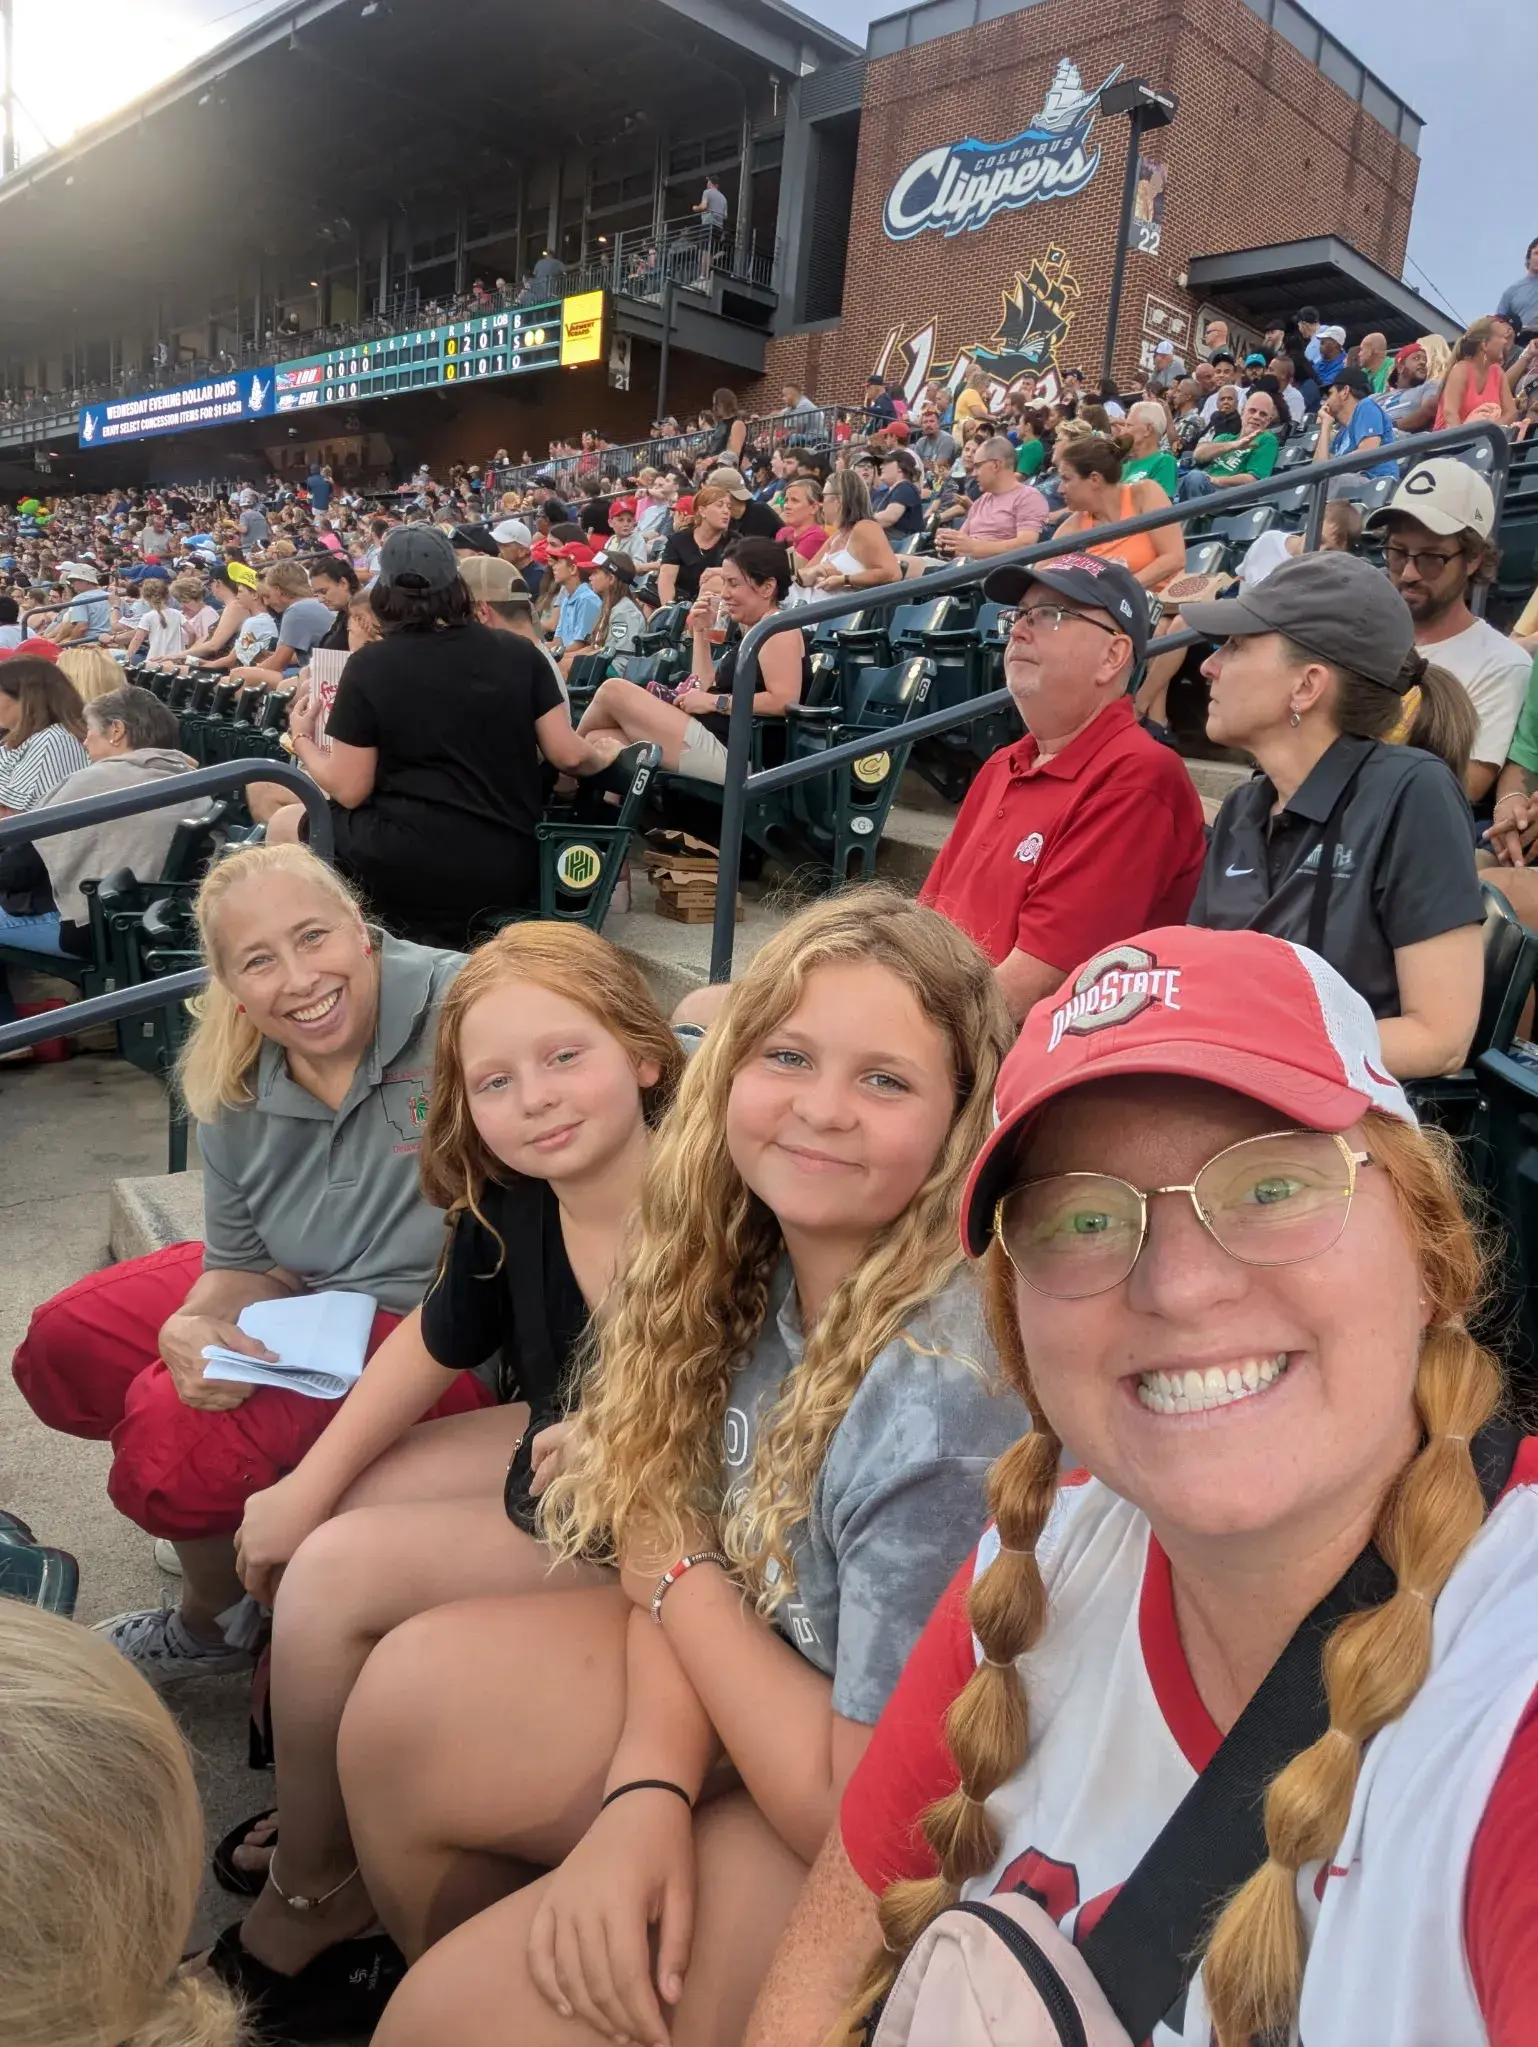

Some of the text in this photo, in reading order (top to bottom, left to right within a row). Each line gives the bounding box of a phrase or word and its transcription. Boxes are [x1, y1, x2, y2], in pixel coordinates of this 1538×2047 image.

[975, 137, 1074, 172] COLUMBUS
[887, 145, 1098, 229] Clippers
[1137, 227, 1161, 256] 22
[339, 351, 344, 360] 2
[351, 348, 356, 358] 3
[363, 345, 368, 356] 4
[376, 342, 381, 353] 5
[389, 339, 395, 350] 6
[402, 335, 408, 347] 7
[430, 330, 436, 341] 9
[449, 325, 455, 337] R
[464, 322, 471, 333] H
[481, 318, 488, 329] E
[493, 314, 508, 327] LOB
[514, 314, 521, 329] B
[326, 365, 333, 379] 0
[338, 362, 345, 377] 0
[350, 360, 357, 375] 0
[362, 357, 369, 372] 0
[447, 340, 455, 355] 0
[463, 336, 471, 352] 2
[479, 332, 488, 349] 0
[497, 329, 503, 345] 1
[513, 335, 520, 350] S
[326, 387, 333, 401] 0
[338, 385, 345, 399] 0
[350, 382, 357, 397] 0
[446, 364, 455, 380] 0
[463, 361, 470, 377] 1
[478, 358, 487, 374] 0
[496, 355, 503, 371] 1
[615, 374, 630, 391] 21
[106, 379, 237, 420] WEDNESDAY EVENING DOLLAR DAYS
[120, 419, 141, 434] SELECT
[140, 412, 180, 430] CONCESSION
[180, 408, 199, 424] ITEMS
[199, 407, 214, 420] FOR
[214, 403, 222, 417] $1
[222, 400, 242, 415] EACH
[1404, 470, 1436, 495] C
[918, 679, 930, 700] 6
[634, 771, 648, 792] 5
[1047, 970, 1182, 1053] OHIO STATE
